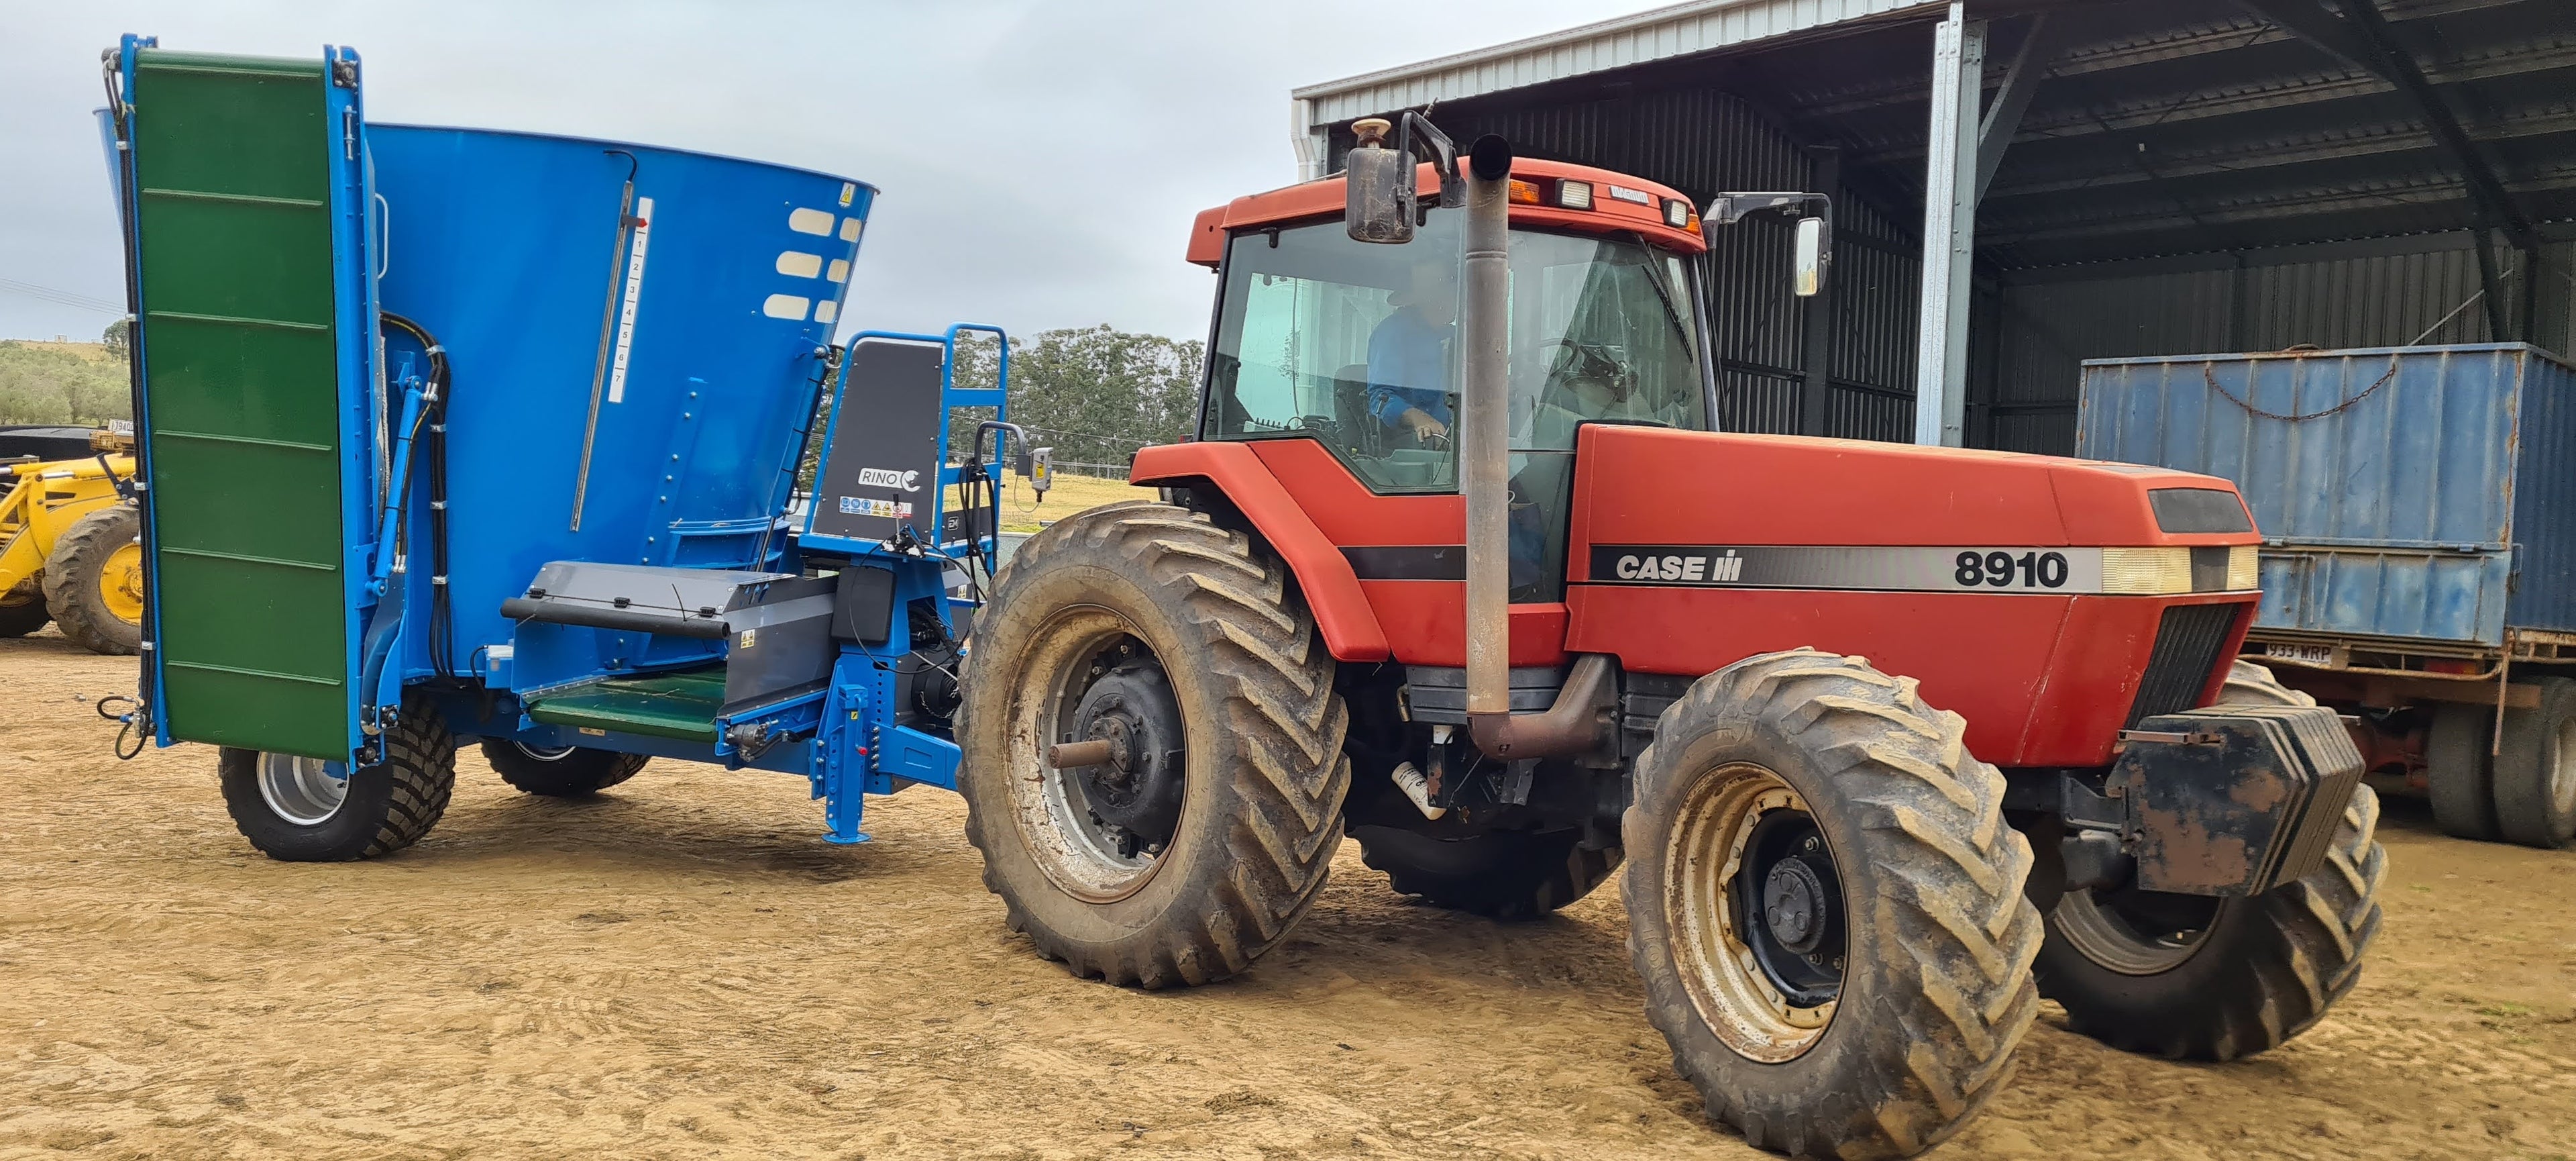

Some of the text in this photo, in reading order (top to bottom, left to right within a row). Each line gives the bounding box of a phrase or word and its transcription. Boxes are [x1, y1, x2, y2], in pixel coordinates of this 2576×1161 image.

[633, 263, 639, 271] 2
[615, 374, 621, 383] 7
[862, 470, 897, 485] RINO
[1617, 555, 1707, 580] CASE
[1955, 551, 2069, 588] 8910
